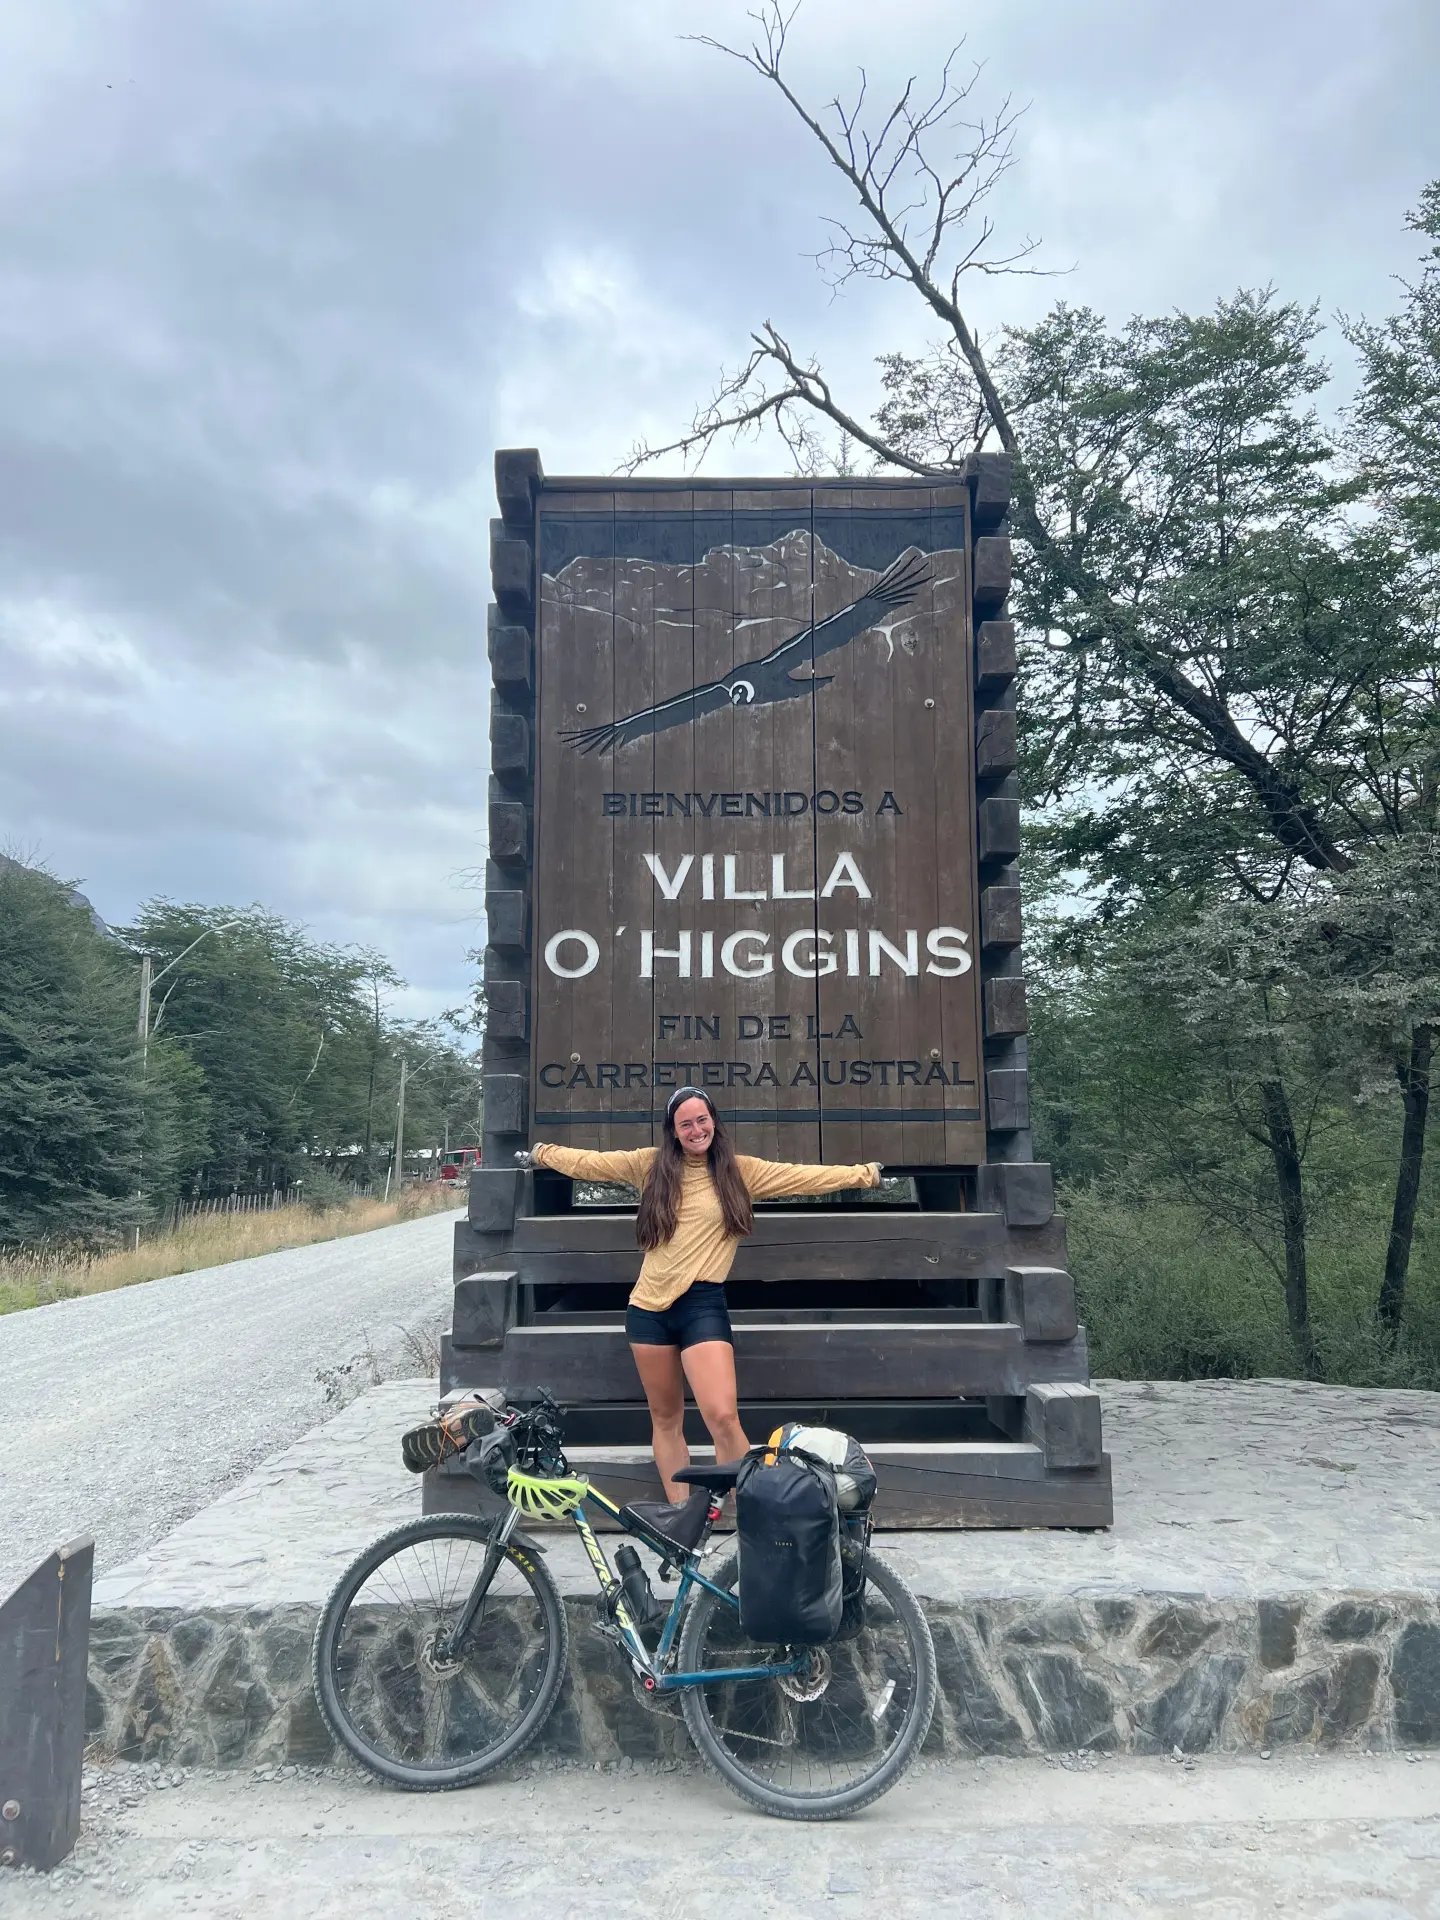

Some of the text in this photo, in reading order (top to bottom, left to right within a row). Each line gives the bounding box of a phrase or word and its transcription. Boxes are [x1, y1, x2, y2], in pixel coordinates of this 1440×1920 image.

[601, 790, 904, 817] BIENVENIDOS A
[642, 851, 872, 901] VILLA
[657, 1014, 864, 1041] FIN DE LA
[539, 1060, 975, 1089] CARRETERA AUSTRAL
[507, 1546, 536, 1573] XXIS
[575, 1519, 632, 1629] MERA
